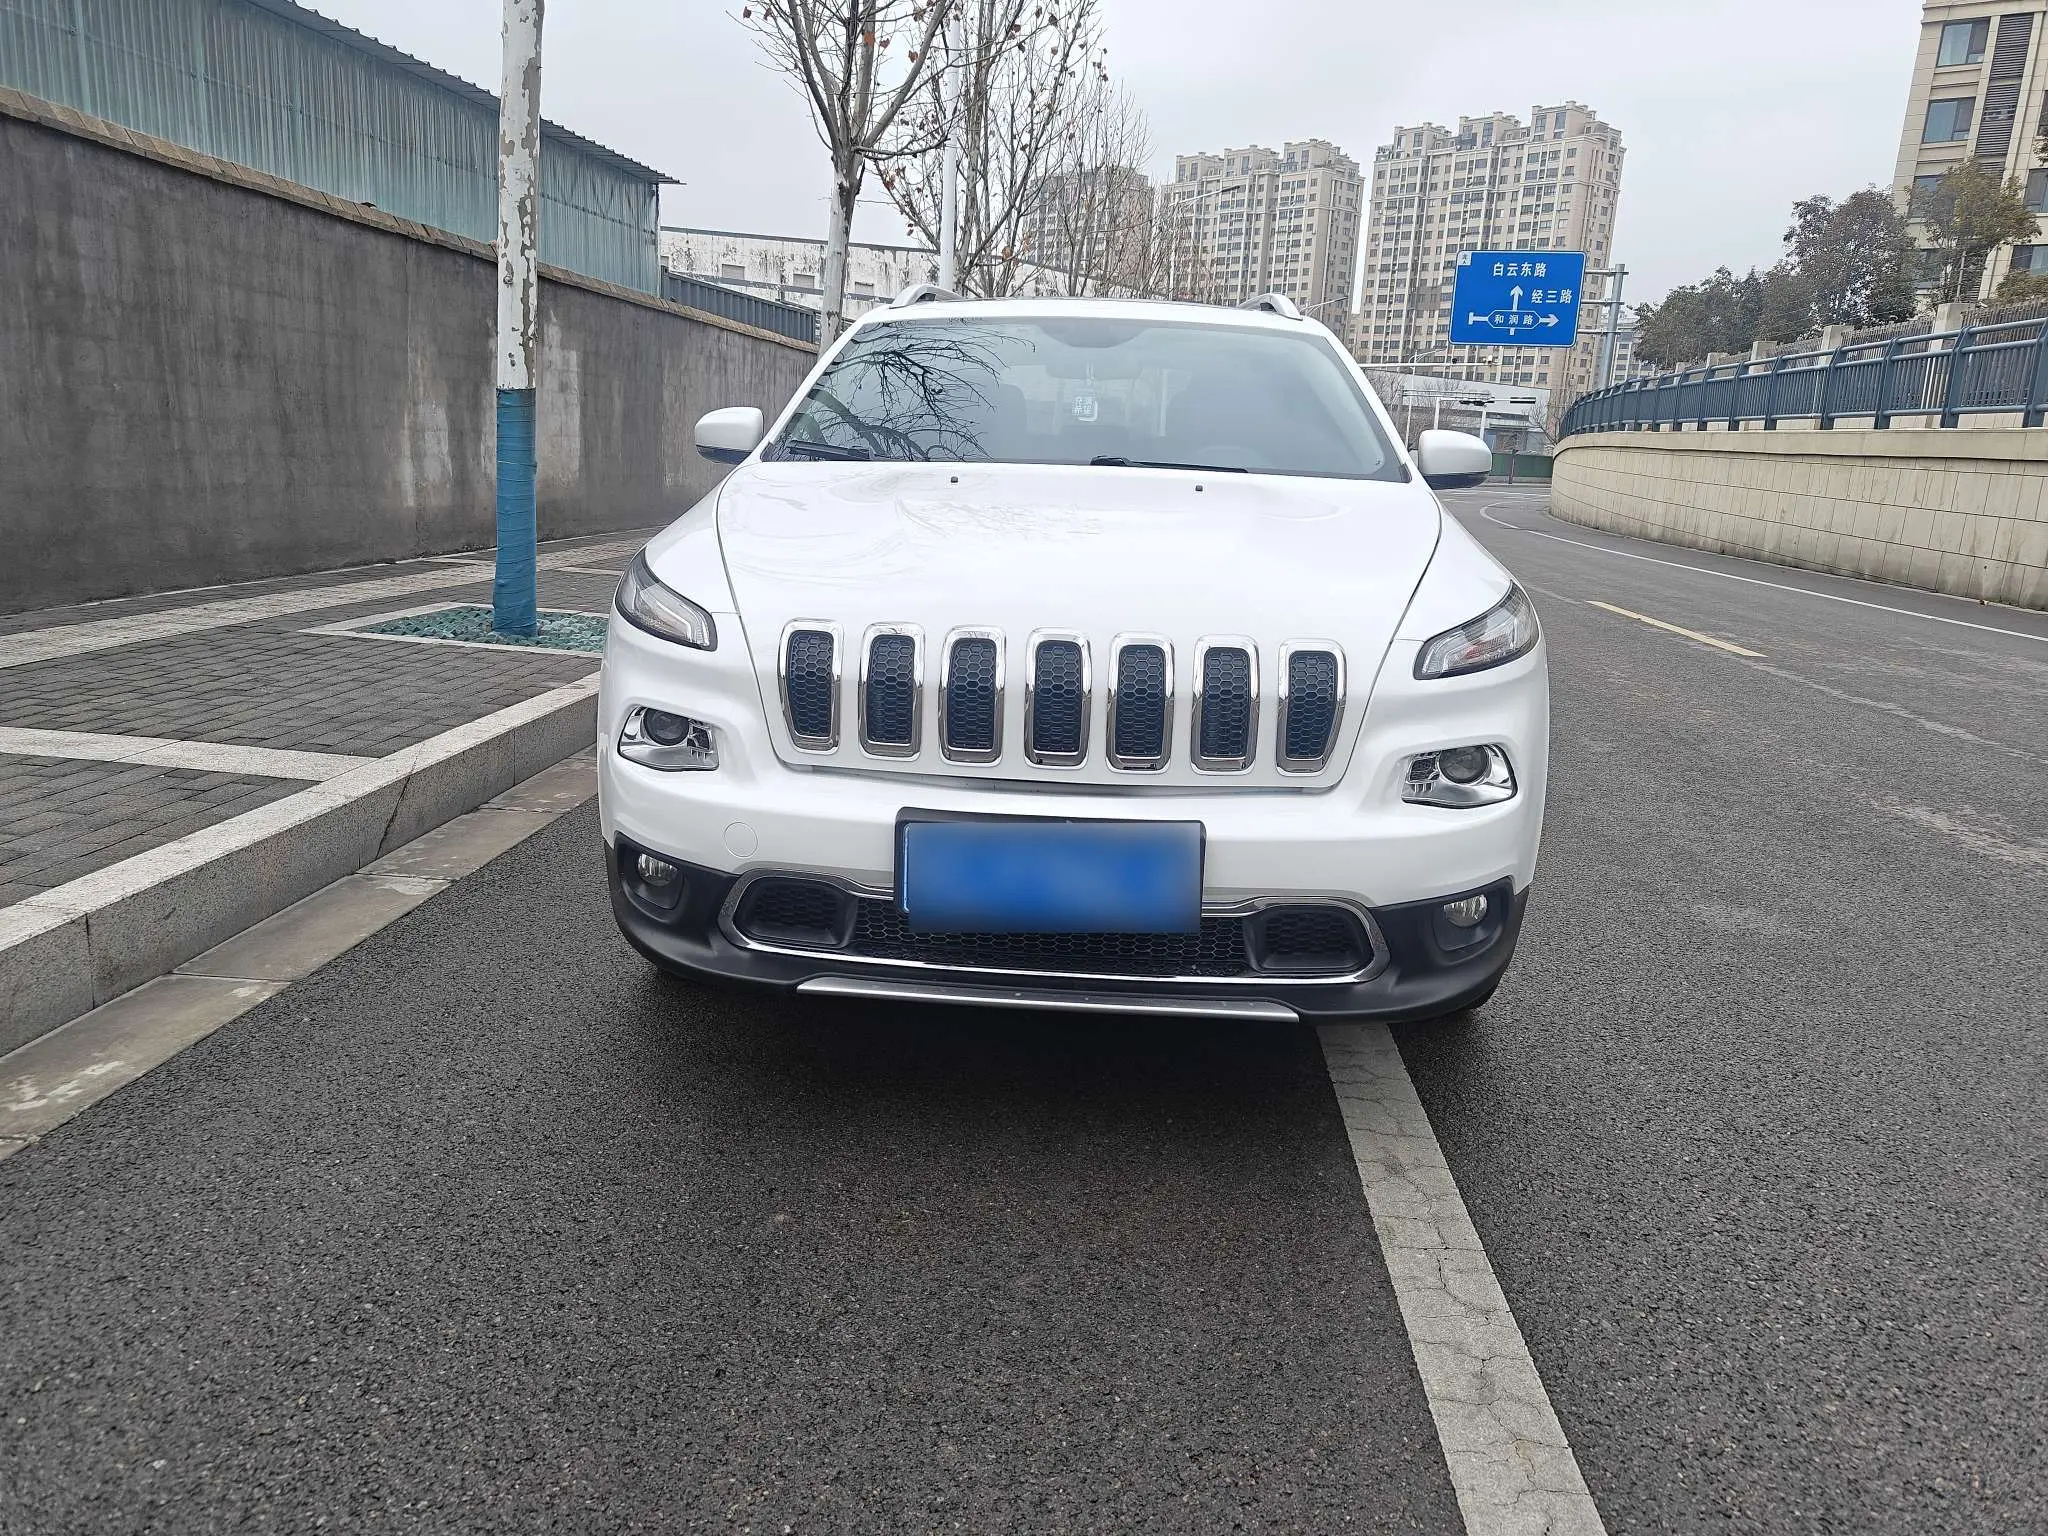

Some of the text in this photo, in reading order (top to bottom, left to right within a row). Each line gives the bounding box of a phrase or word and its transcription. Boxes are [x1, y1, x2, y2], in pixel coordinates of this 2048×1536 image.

[1493, 262, 1547, 277] 白云东路
[1531, 289, 1572, 304] 经三路
